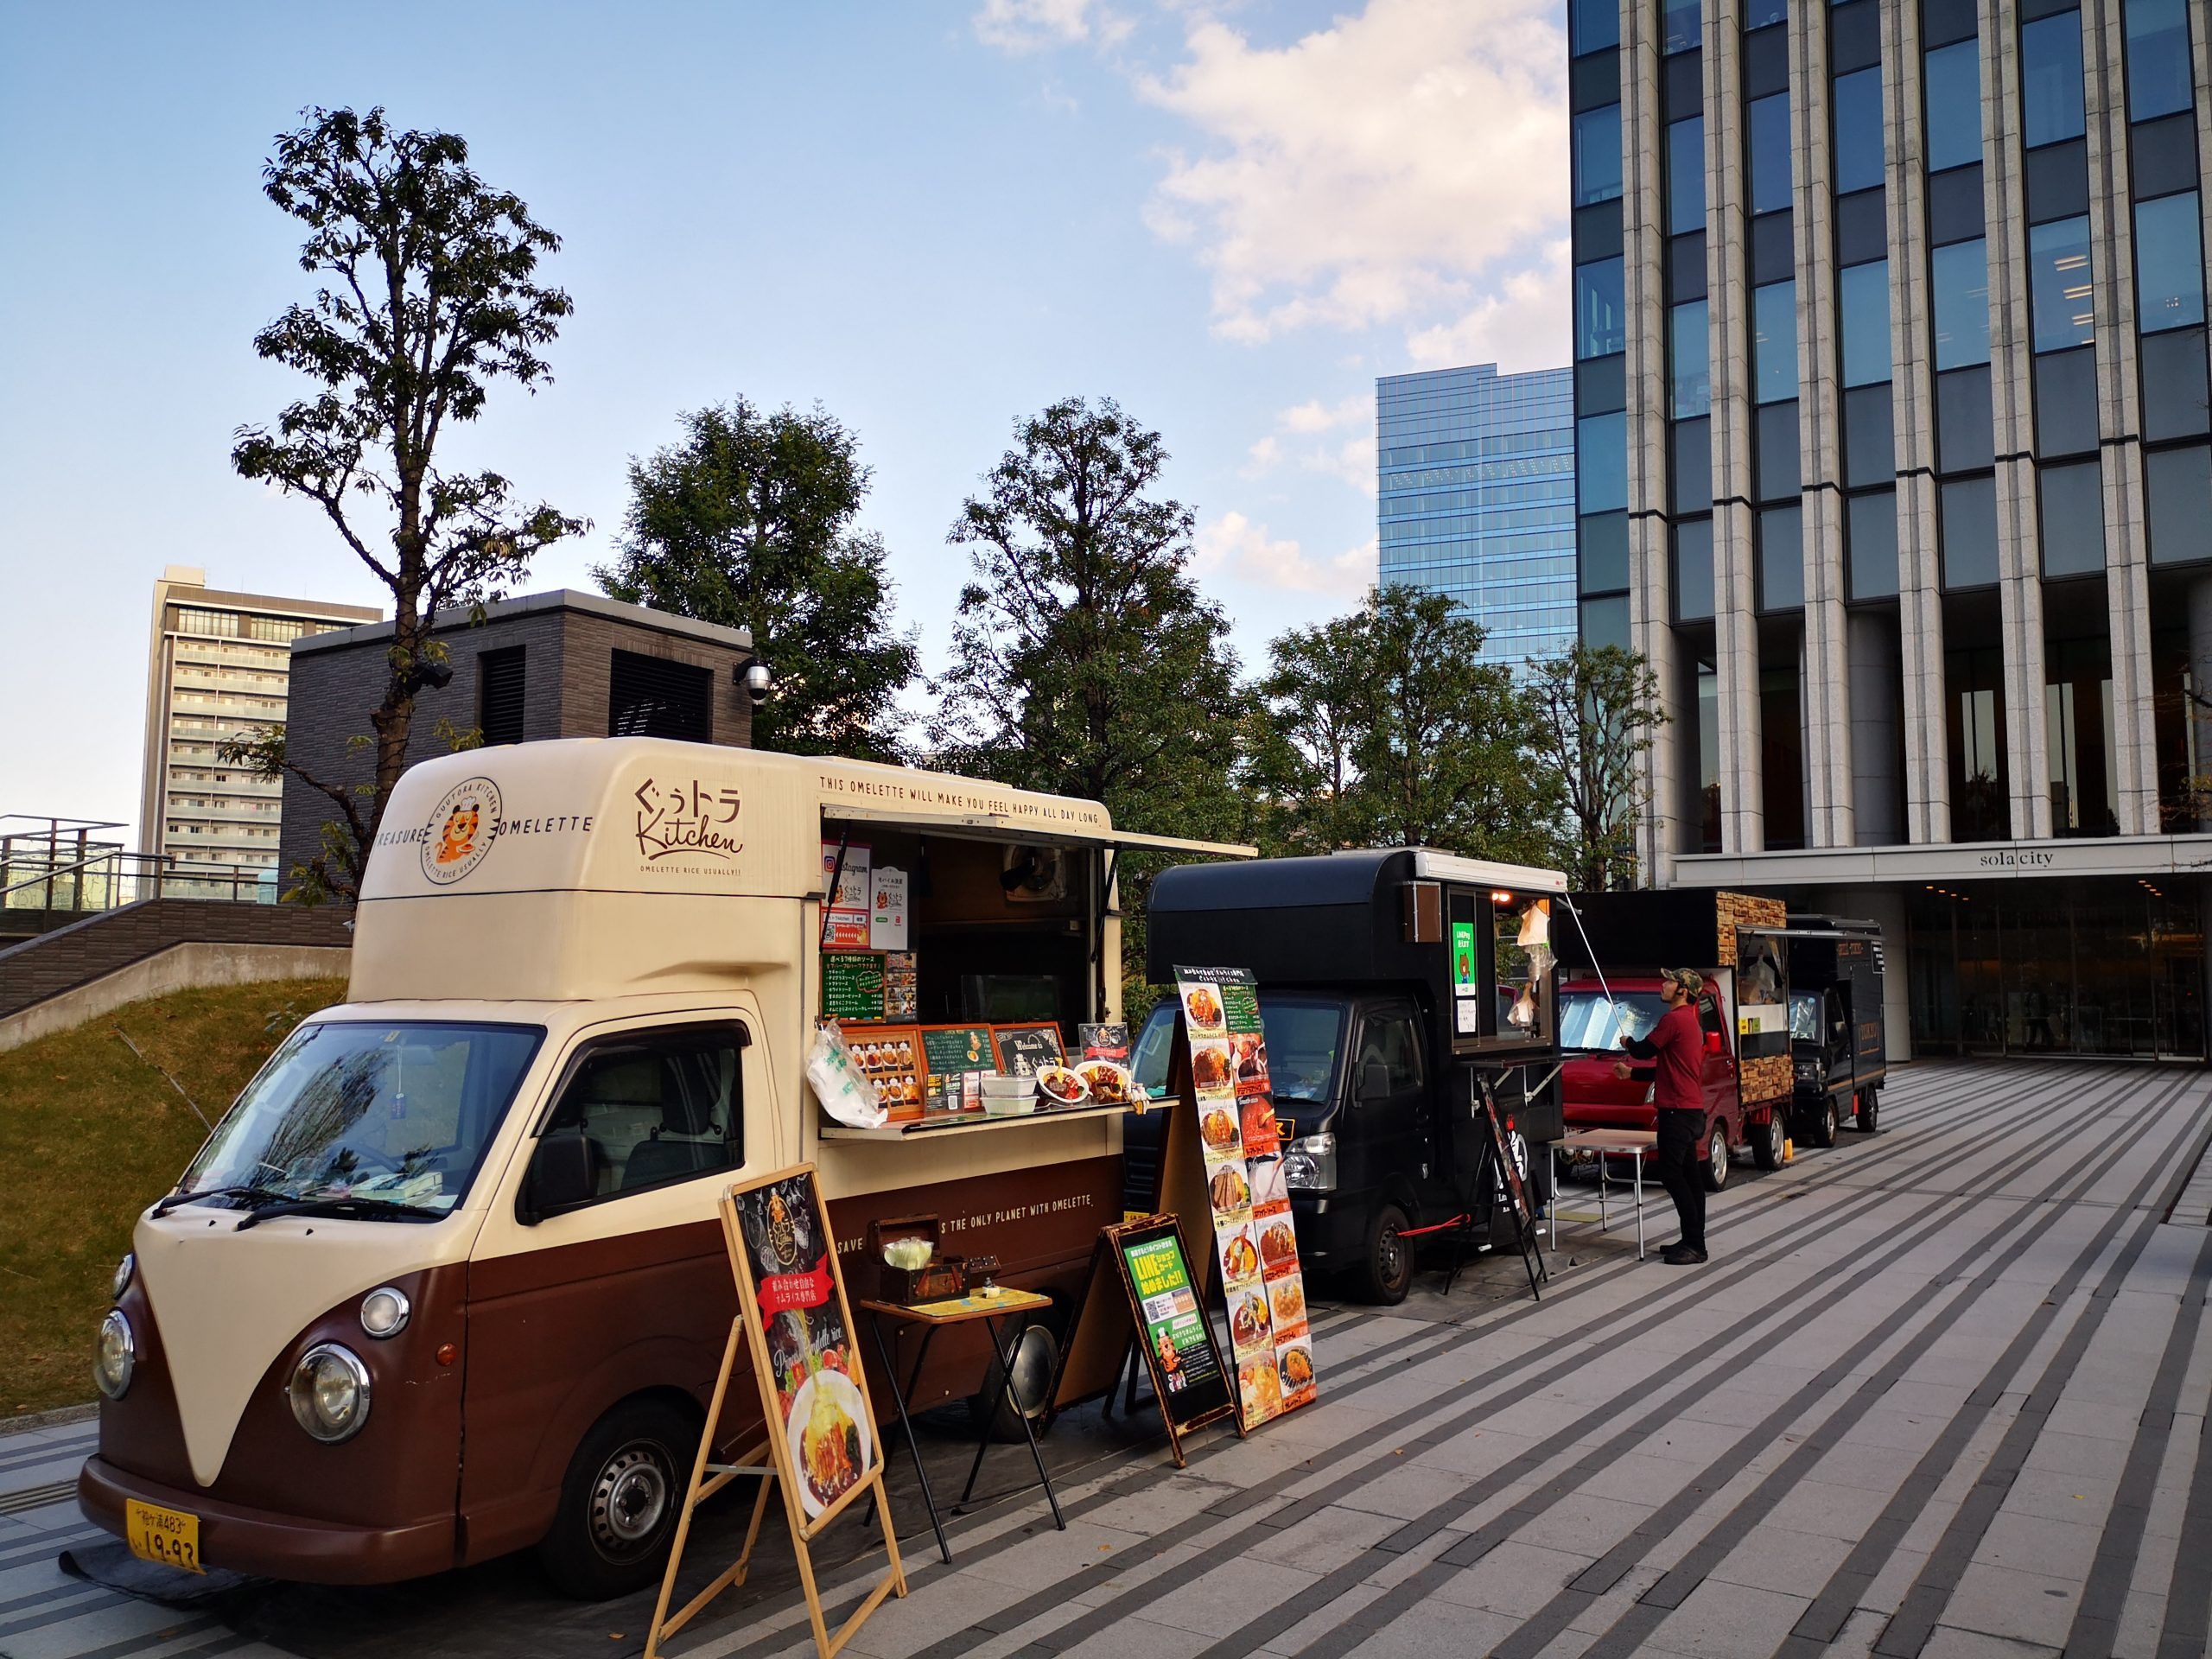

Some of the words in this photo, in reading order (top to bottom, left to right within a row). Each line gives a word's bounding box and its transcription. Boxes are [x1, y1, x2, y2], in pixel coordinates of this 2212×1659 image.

[435, 784, 472, 818] GUUTORA
[476, 783, 498, 814] KITCHEN
[820, 776, 843, 791] THIS
[850, 781, 904, 798] OMELETTE
[910, 788, 932, 802] WILL
[938, 792, 963, 806] MAKE
[967, 797, 983, 810] YOU
[988, 800, 1008, 812] FEEL
[1013, 803, 1038, 816] HAPPY
[1043, 807, 1057, 818] ALL
[1061, 809, 1074, 821] DAY
[377, 828, 424, 847] REASURE
[499, 817, 594, 836] OMELETTE
[635, 807, 743, 855] Kitchen
[459, 842, 486, 873] USUALLY
[640, 865, 680, 874] OMELETTE
[950, 1217, 966, 1232] THE
[970, 1213, 992, 1228] ONLY
[995, 1206, 1027, 1223] PLANET
[1030, 1202, 1049, 1217] WITH
[837, 1237, 863, 1254] SAVE
[1133, 1253, 1160, 1281] LINE
